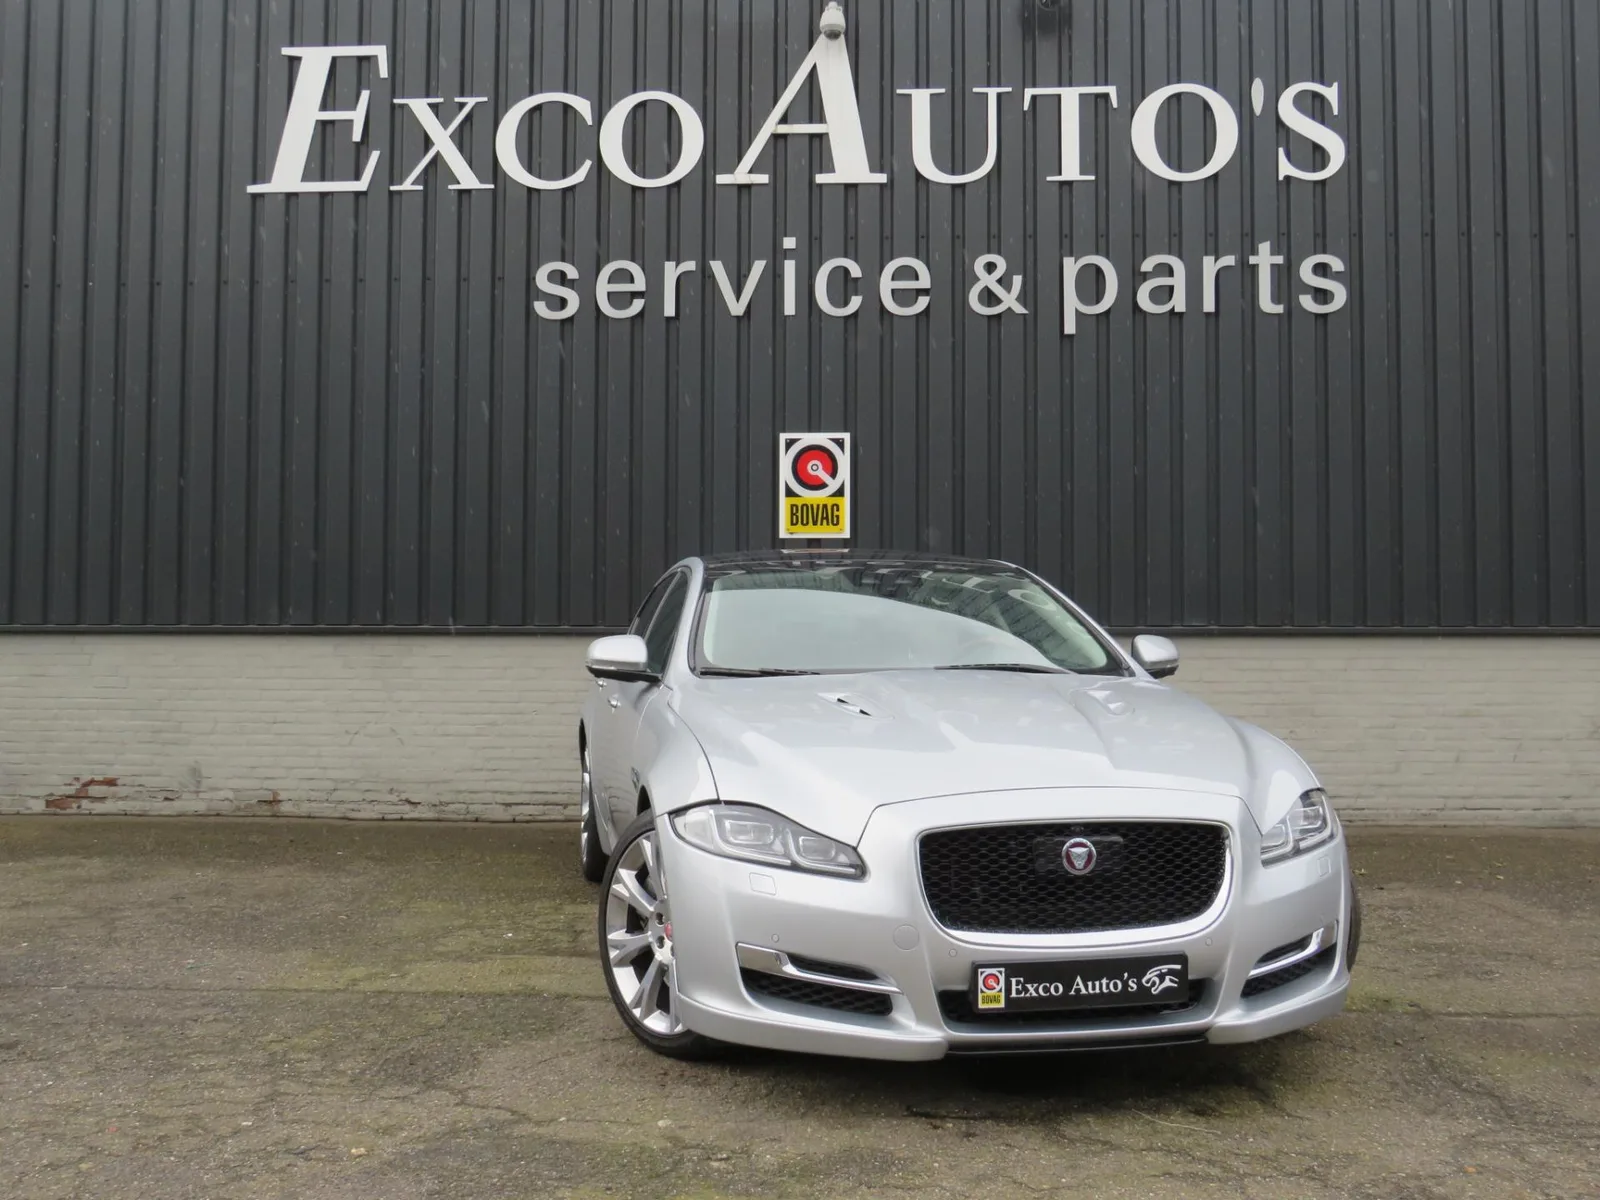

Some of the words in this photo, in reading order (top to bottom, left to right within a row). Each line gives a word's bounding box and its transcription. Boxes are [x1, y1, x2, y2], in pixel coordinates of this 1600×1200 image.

[533, 236, 931, 320] service
[968, 253, 1028, 316] &
[1062, 241, 1348, 336] parts
[790, 503, 840, 527] BOVAG
[1009, 977, 1063, 998] Exco
[1069, 972, 1138, 995] Auto's
[981, 993, 1001, 1005] BOVAG
